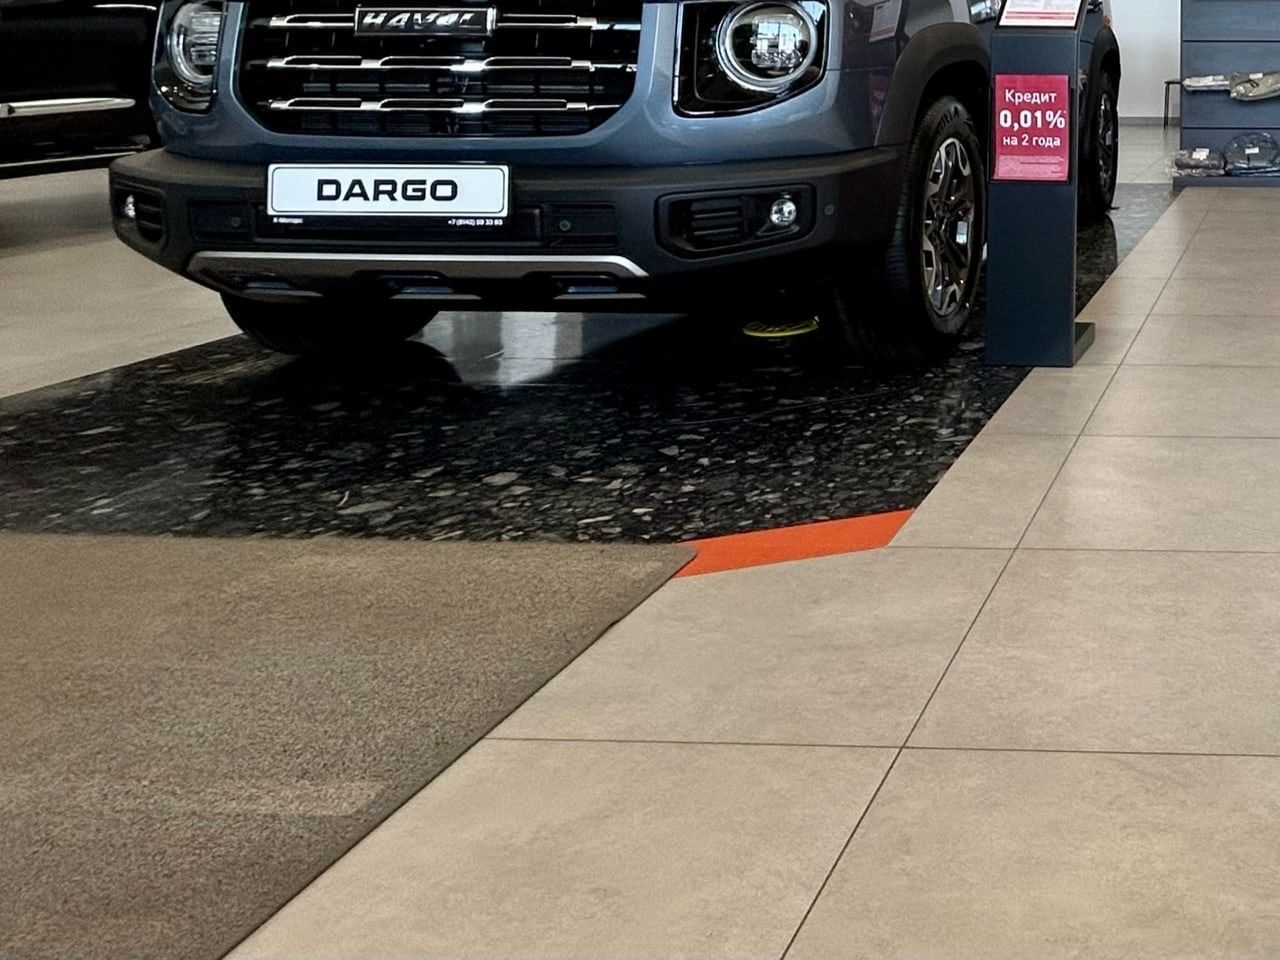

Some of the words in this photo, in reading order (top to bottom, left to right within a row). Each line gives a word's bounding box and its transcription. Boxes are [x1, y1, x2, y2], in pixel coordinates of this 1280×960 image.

[1005, 89, 1057, 105] Кредит
[1003, 136, 1018, 146] на
[1021, 134, 1029, 146] 2
[1032, 136, 1061, 147] года
[317, 179, 458, 201] DARGO
